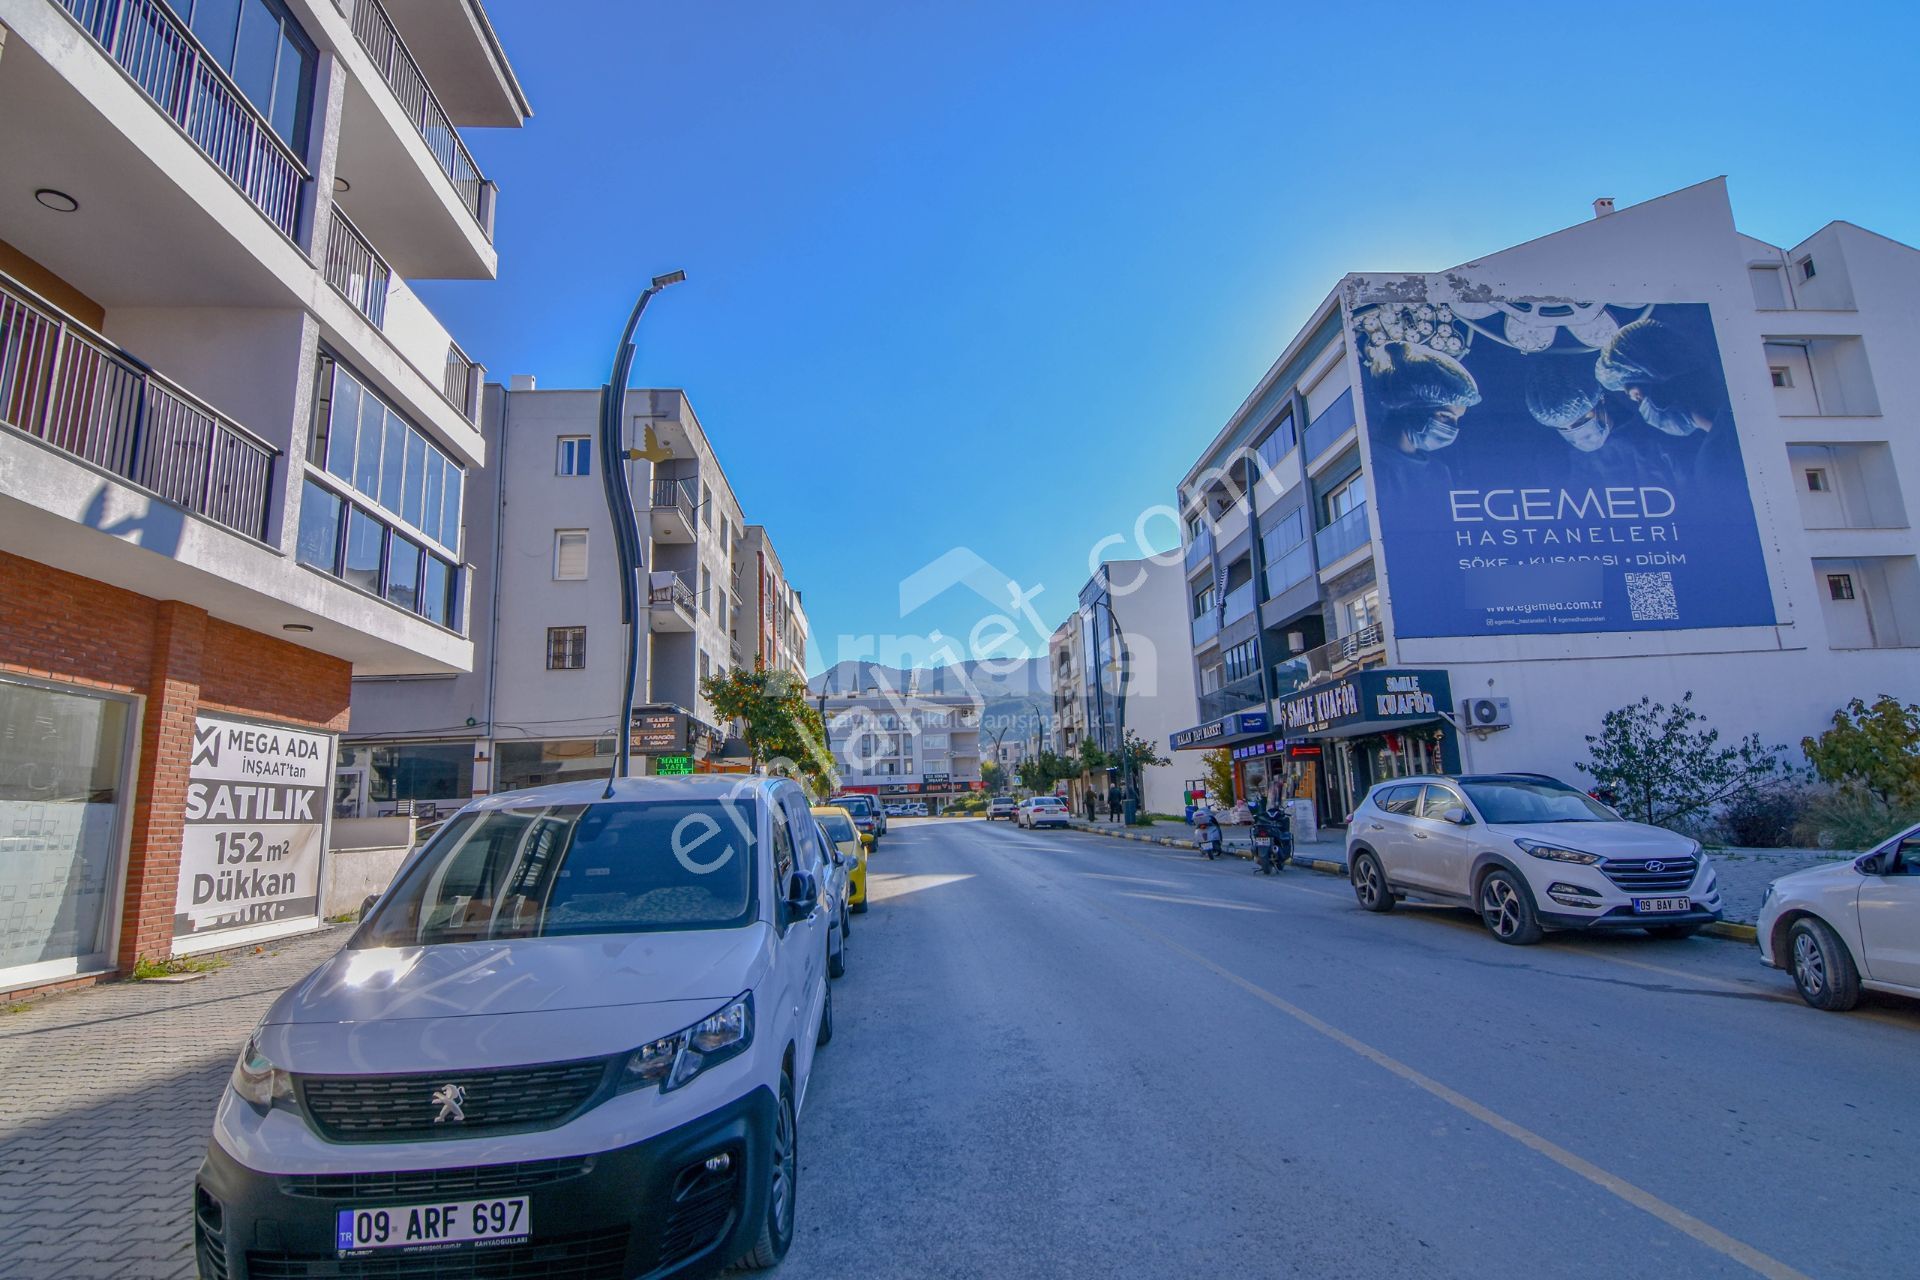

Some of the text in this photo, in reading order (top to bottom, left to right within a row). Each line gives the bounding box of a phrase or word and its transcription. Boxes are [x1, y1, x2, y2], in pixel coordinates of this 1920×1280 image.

[1449, 486, 1676, 522] EGEMED
[1455, 522, 1679, 546] HASTANELERİ
[1635, 551, 1687, 566] DİDİM
[1315, 679, 1359, 722] KUAFÖR
[1376, 690, 1436, 716] KUAFÖR
[227, 729, 319, 760] MEGA ADA
[185, 783, 315, 820] SATILIK
[215, 831, 264, 865] 152
[193, 868, 296, 905] Dükkan
[1640, 900, 1651, 911] 09
[1678, 899, 1689, 910] 61
[357, 1211, 390, 1243] 09
[406, 1206, 459, 1240] ARF
[472, 1200, 524, 1235] 697
